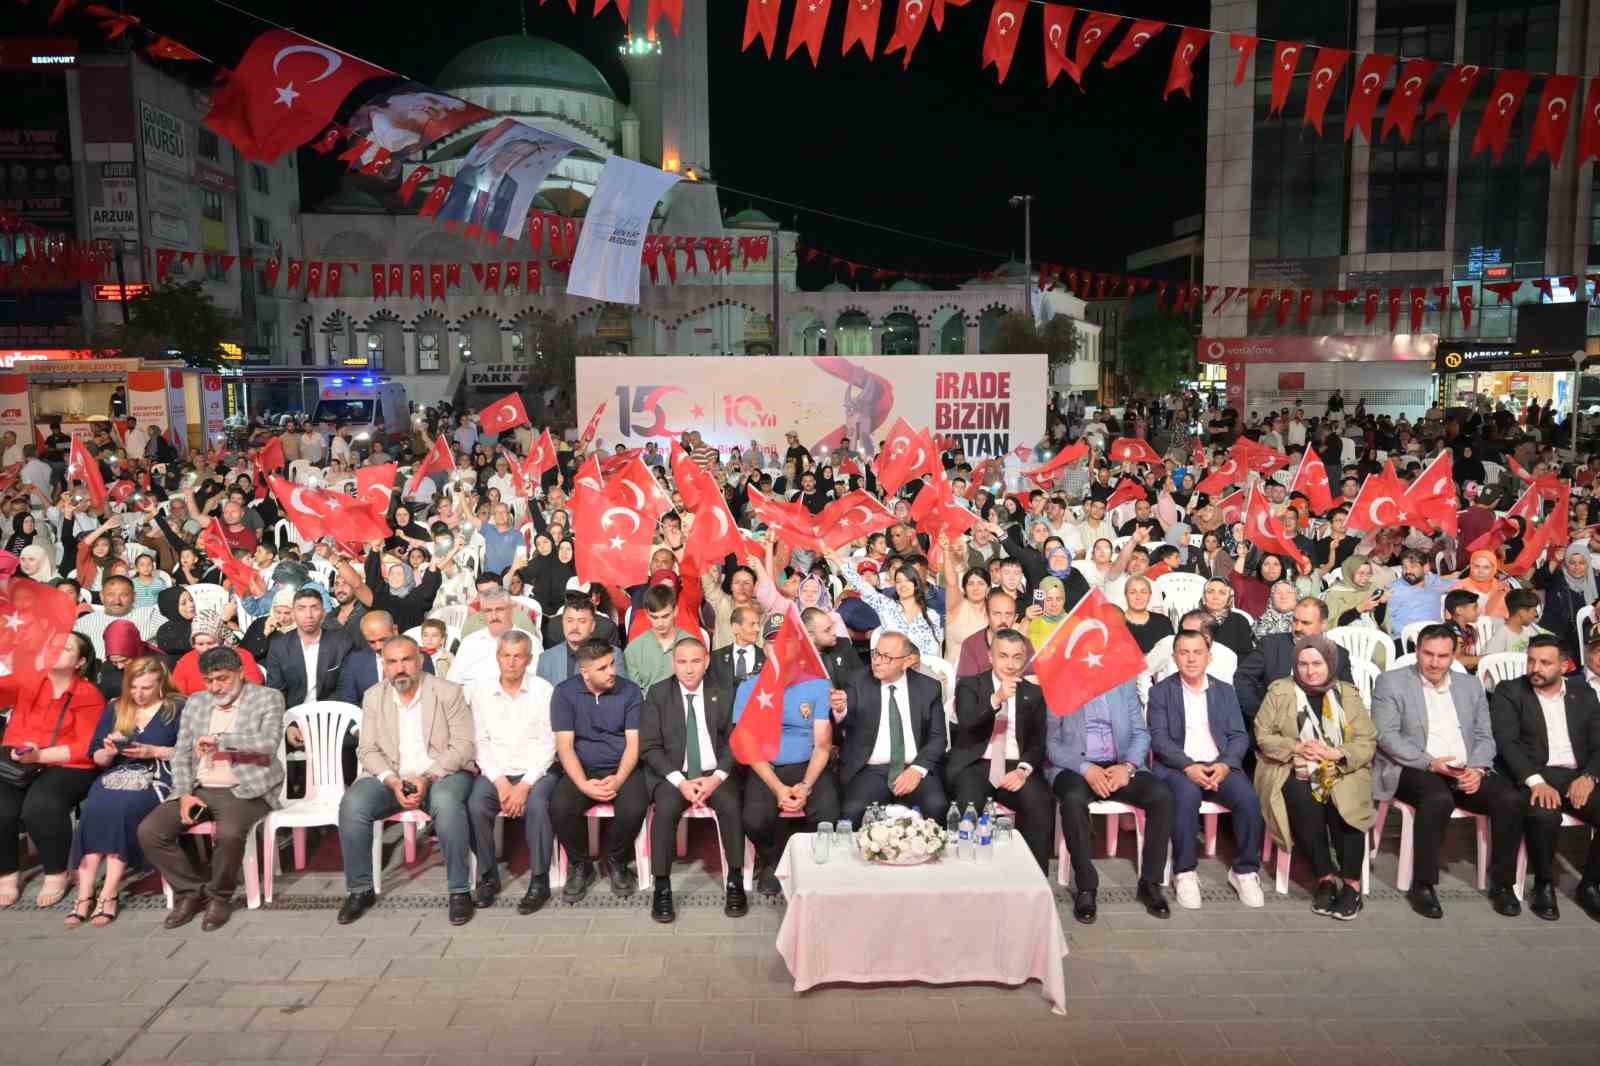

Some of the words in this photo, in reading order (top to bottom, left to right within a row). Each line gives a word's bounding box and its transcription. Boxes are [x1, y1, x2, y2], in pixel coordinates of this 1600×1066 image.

[143, 123, 184, 158] KURSU
[93, 210, 134, 222] ARZUM
[472, 373, 512, 383] PARK
[935, 372, 1010, 399] İRADE
[935, 402, 1010, 430] BİZİM
[936, 433, 1010, 457] ATAN
